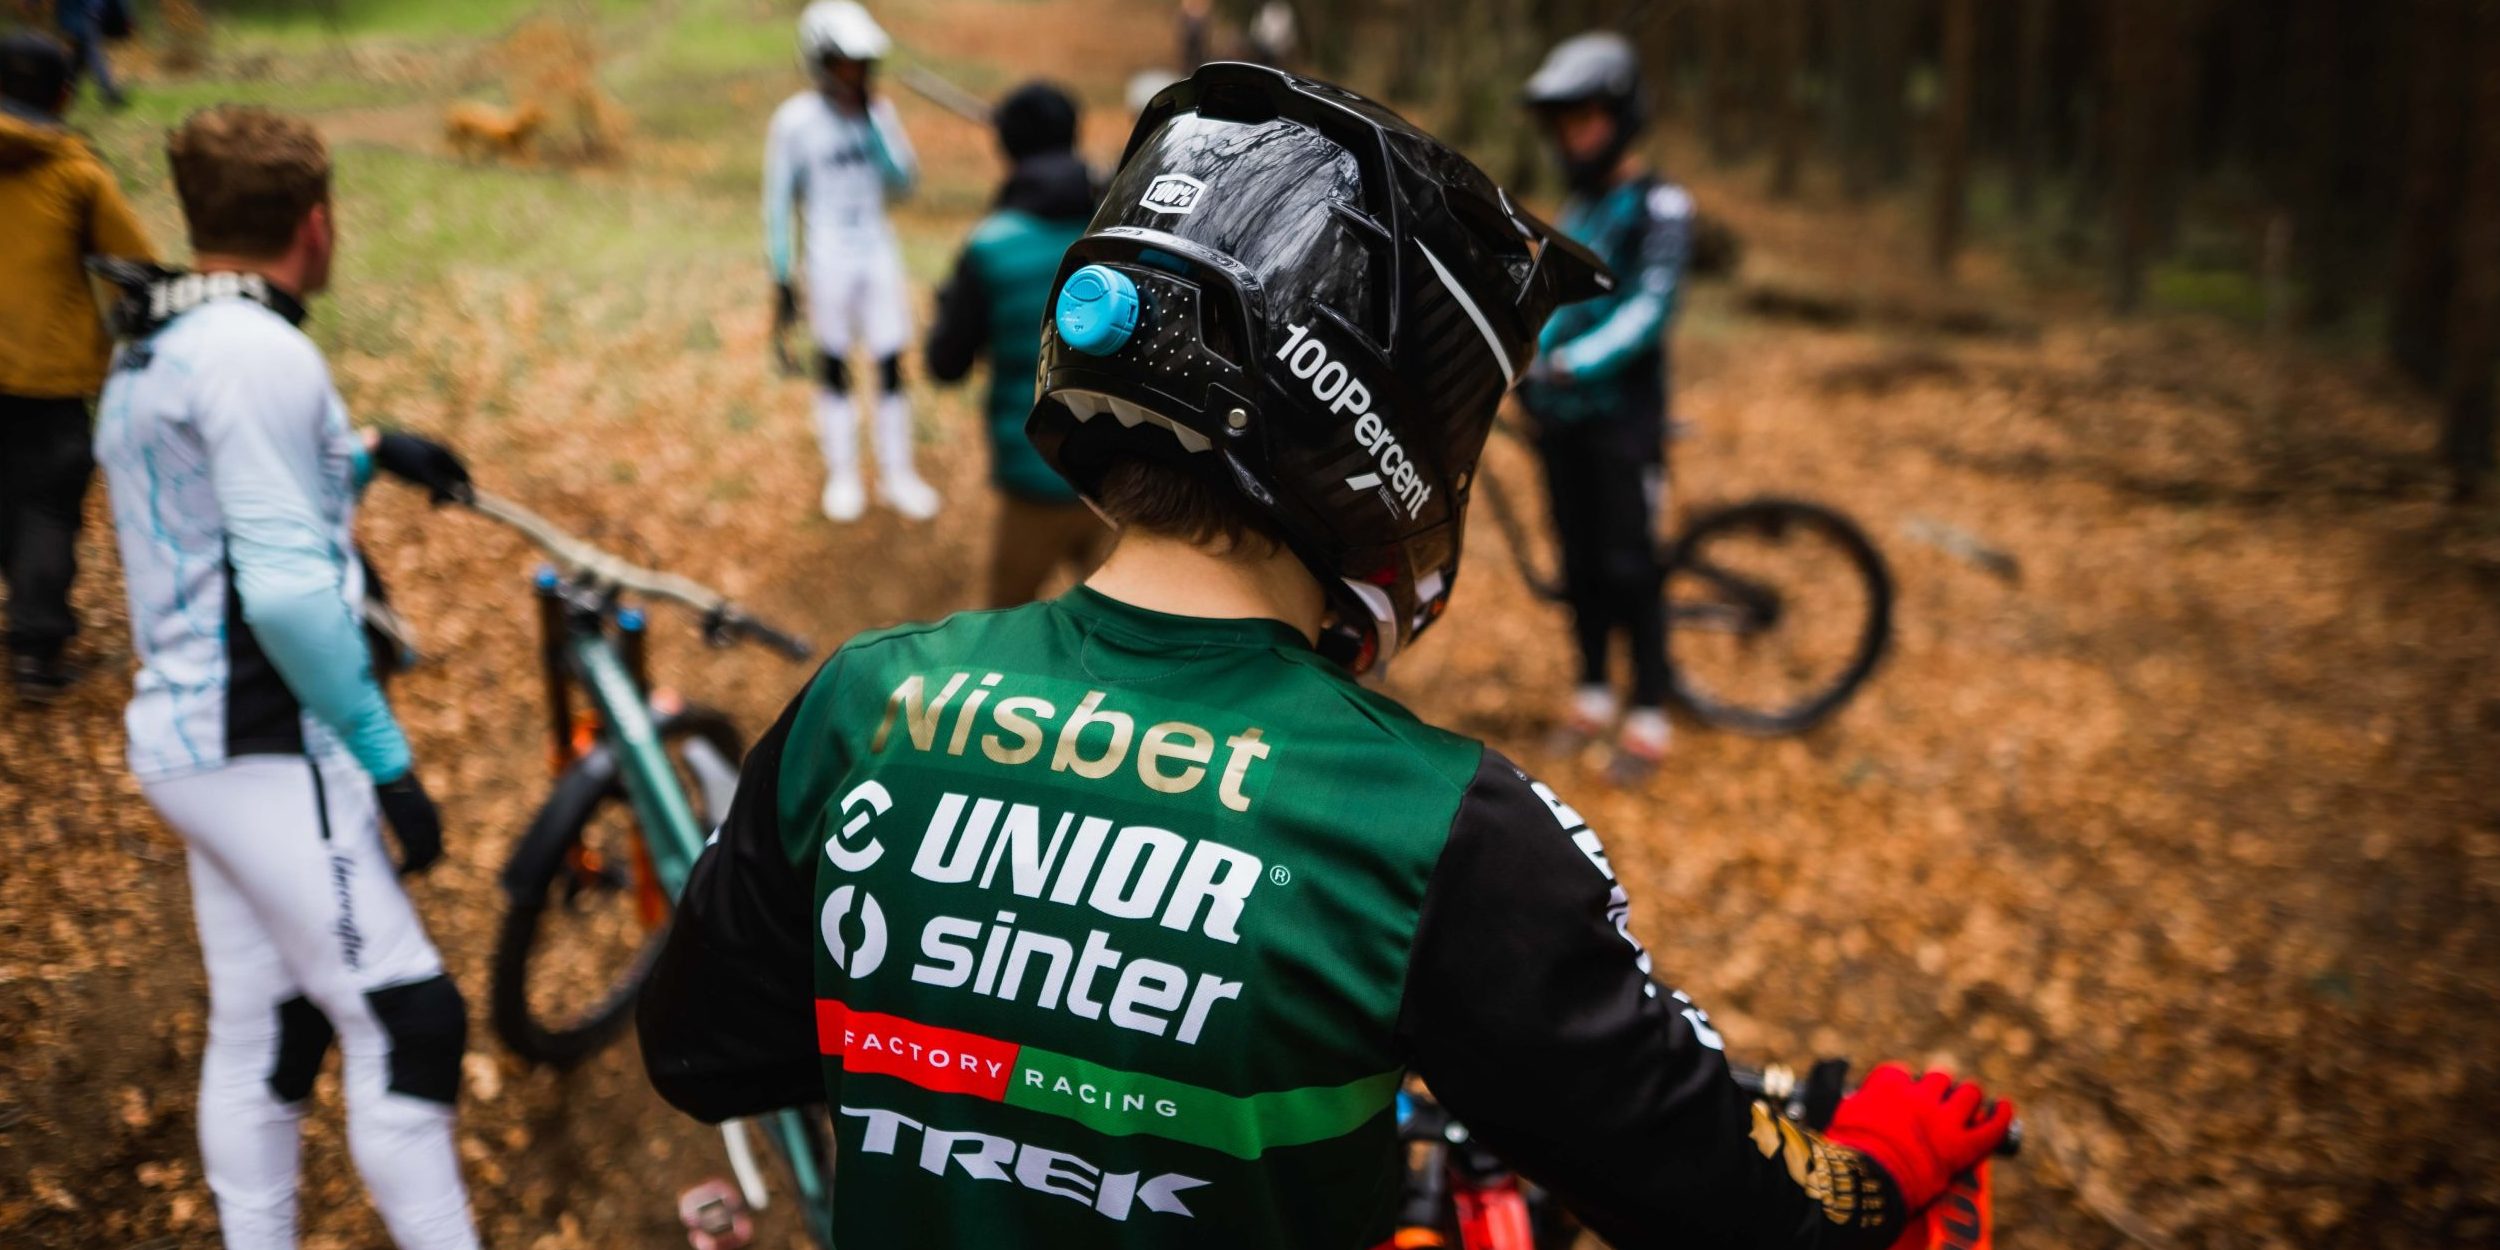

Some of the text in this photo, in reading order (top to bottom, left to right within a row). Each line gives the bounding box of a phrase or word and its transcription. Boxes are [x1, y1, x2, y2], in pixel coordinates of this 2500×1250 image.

[1148, 181, 1198, 207] 100%
[1275, 322, 1432, 521] 100Percent
[871, 672, 1272, 813] Nisbet
[910, 791, 1264, 945] UNIOR
[911, 909, 1244, 1045] sinter
[844, 1029, 1177, 1118] FACTORY RACING
[840, 1104, 1214, 1221] TREK
